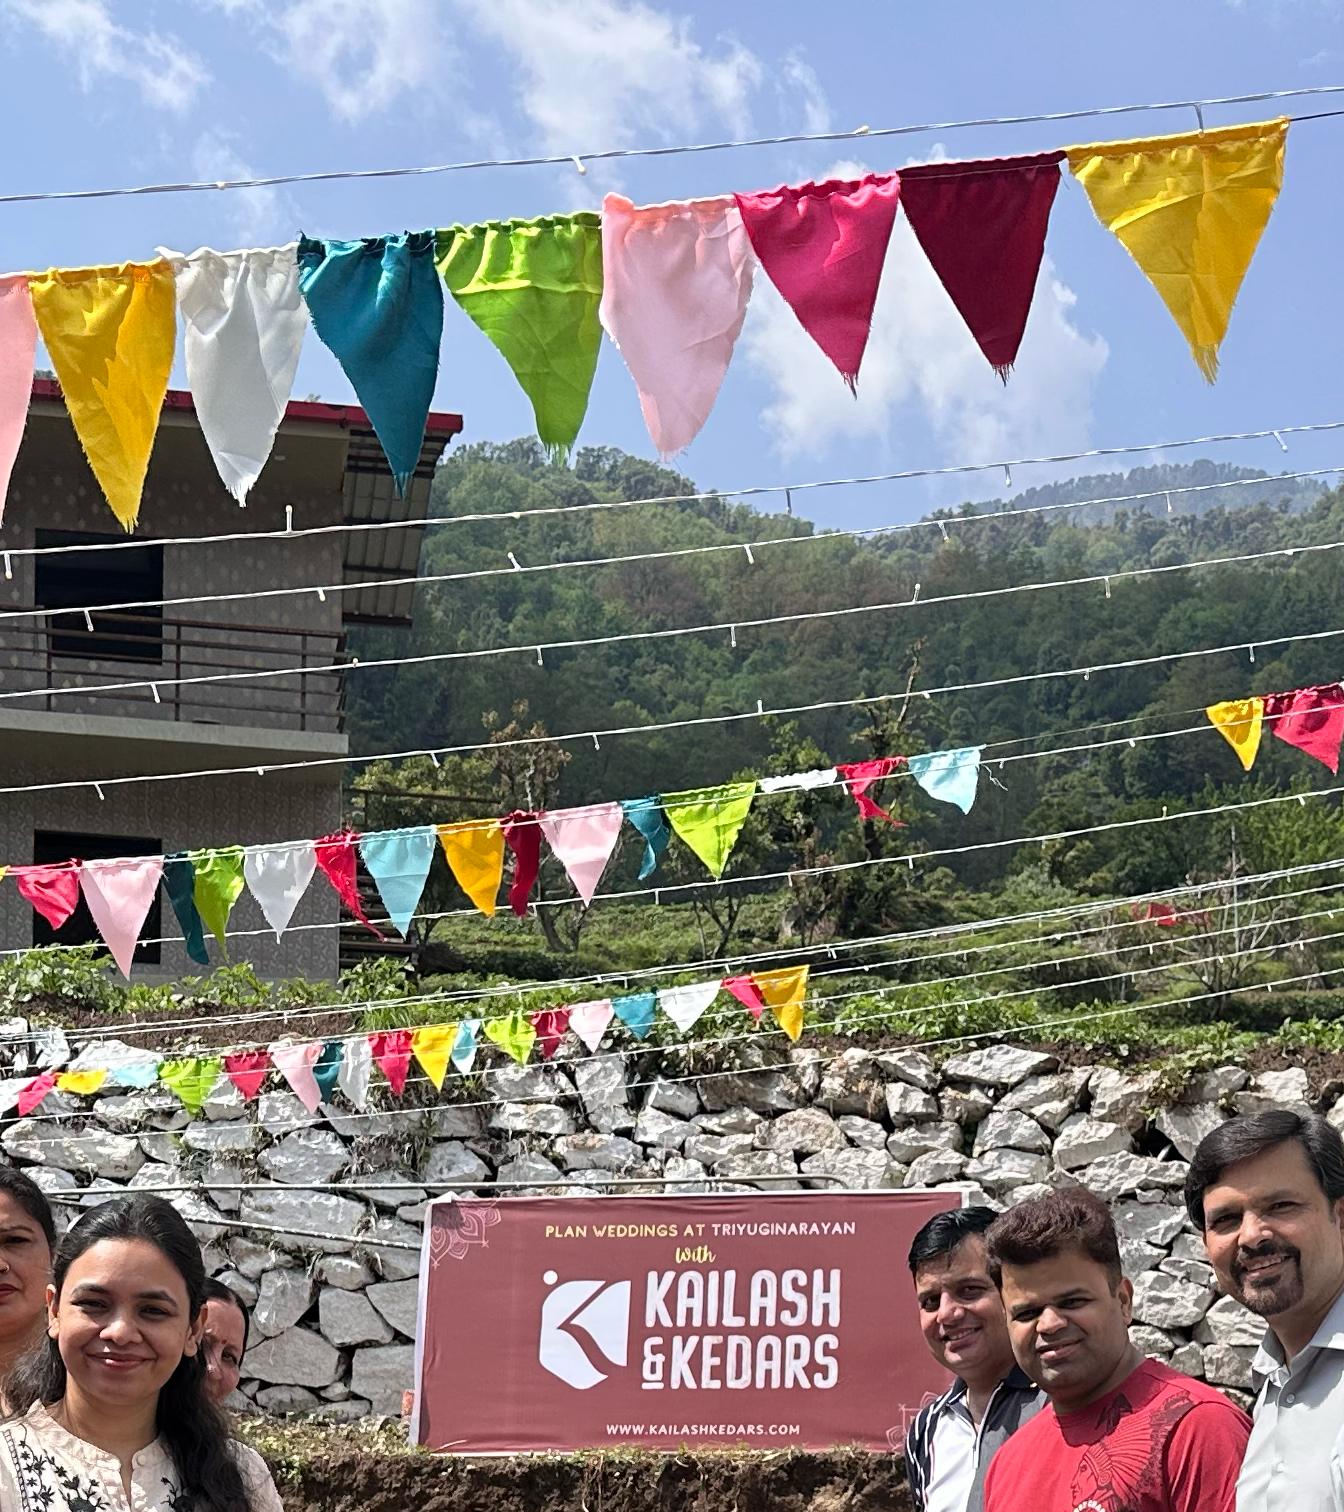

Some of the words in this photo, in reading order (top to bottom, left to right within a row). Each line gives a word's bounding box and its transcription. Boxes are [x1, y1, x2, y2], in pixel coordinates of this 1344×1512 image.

[545, 1224, 587, 1238] PLAN
[592, 1223, 678, 1238] WEDDINGS
[683, 1222, 706, 1237] AT
[712, 1221, 857, 1237] TRIYUGINARAYAN
[674, 1244, 717, 1265] with
[645, 1268, 842, 1328] KAILASH
[606, 1423, 801, 1436] WWW.KAILASHKEDARS.COM
